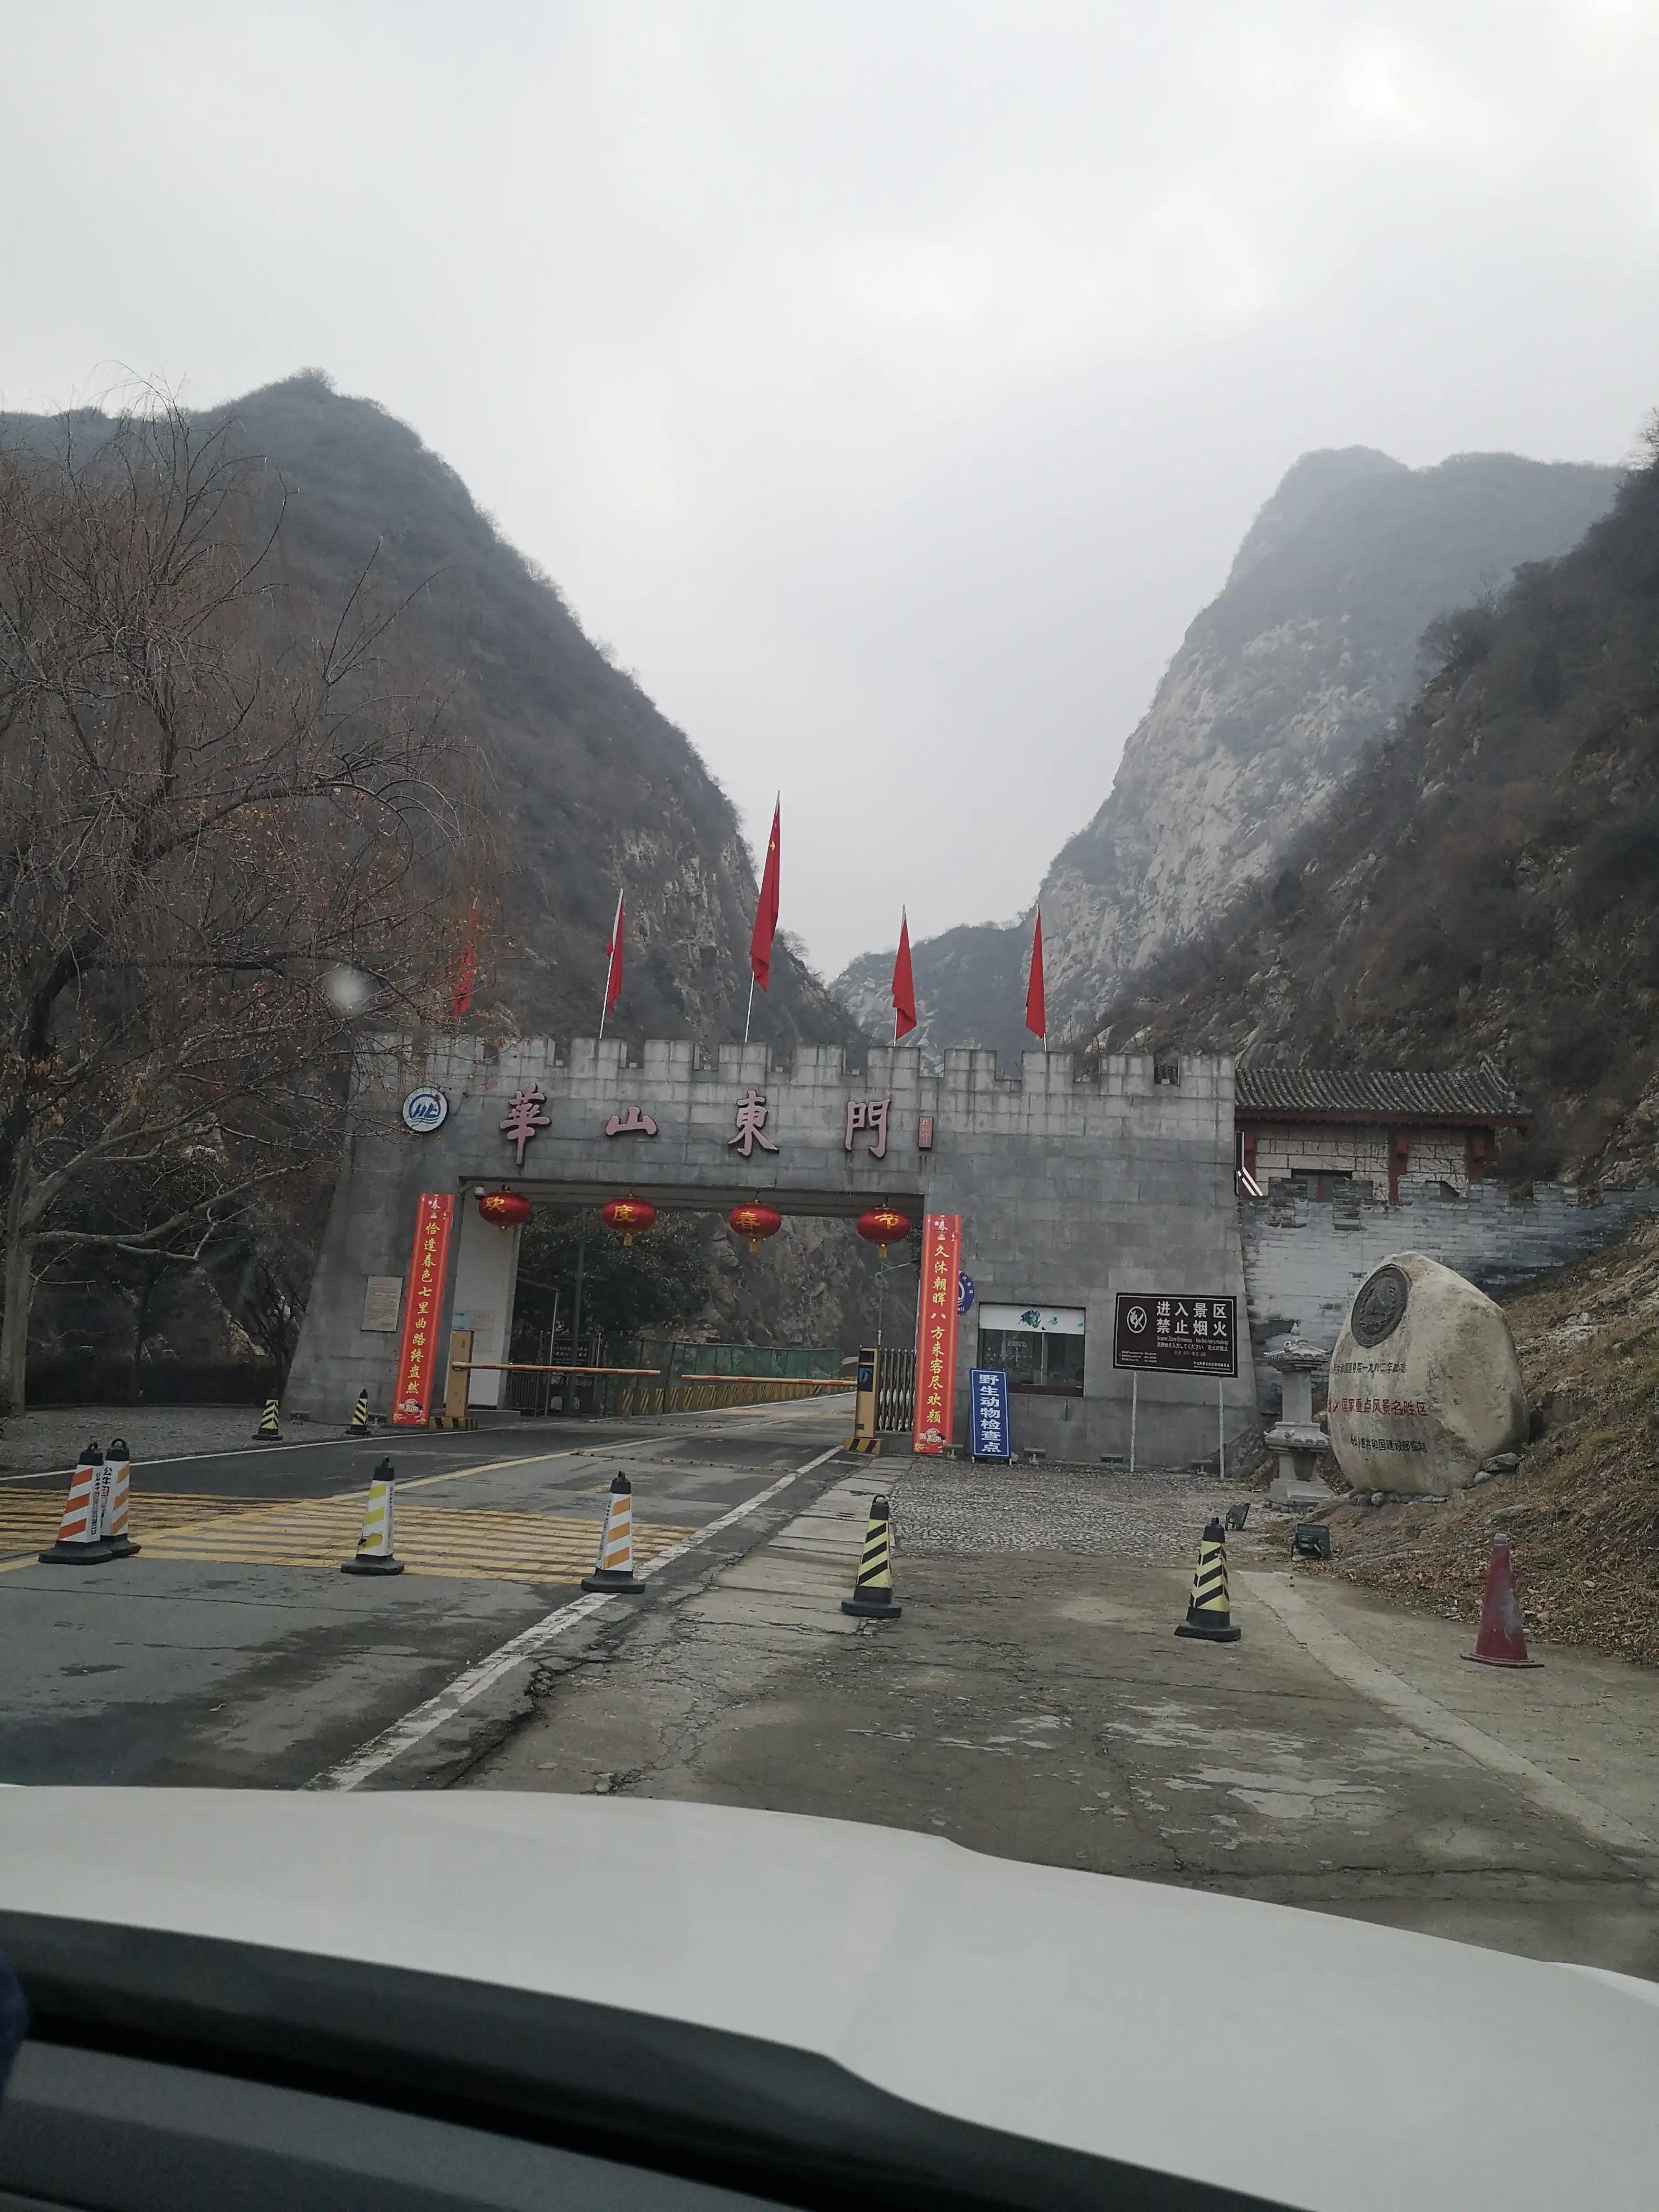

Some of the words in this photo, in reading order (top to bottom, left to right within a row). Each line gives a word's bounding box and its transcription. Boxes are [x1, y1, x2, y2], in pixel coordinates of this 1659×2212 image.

[499, 1082, 891, 1166] 華山東門
[484, 1196, 505, 1212] 欢
[613, 1204, 636, 1223] 度
[736, 1211, 760, 1229] 春
[875, 1213, 899, 1229] 节
[926, 1244, 950, 1424] 久沐朝晖八方来客尽欢颜
[1156, 1301, 1227, 1318] 进入景区
[1156, 1318, 1228, 1337] 禁止烟火
[978, 1374, 1002, 1453] 野生动物检查点
